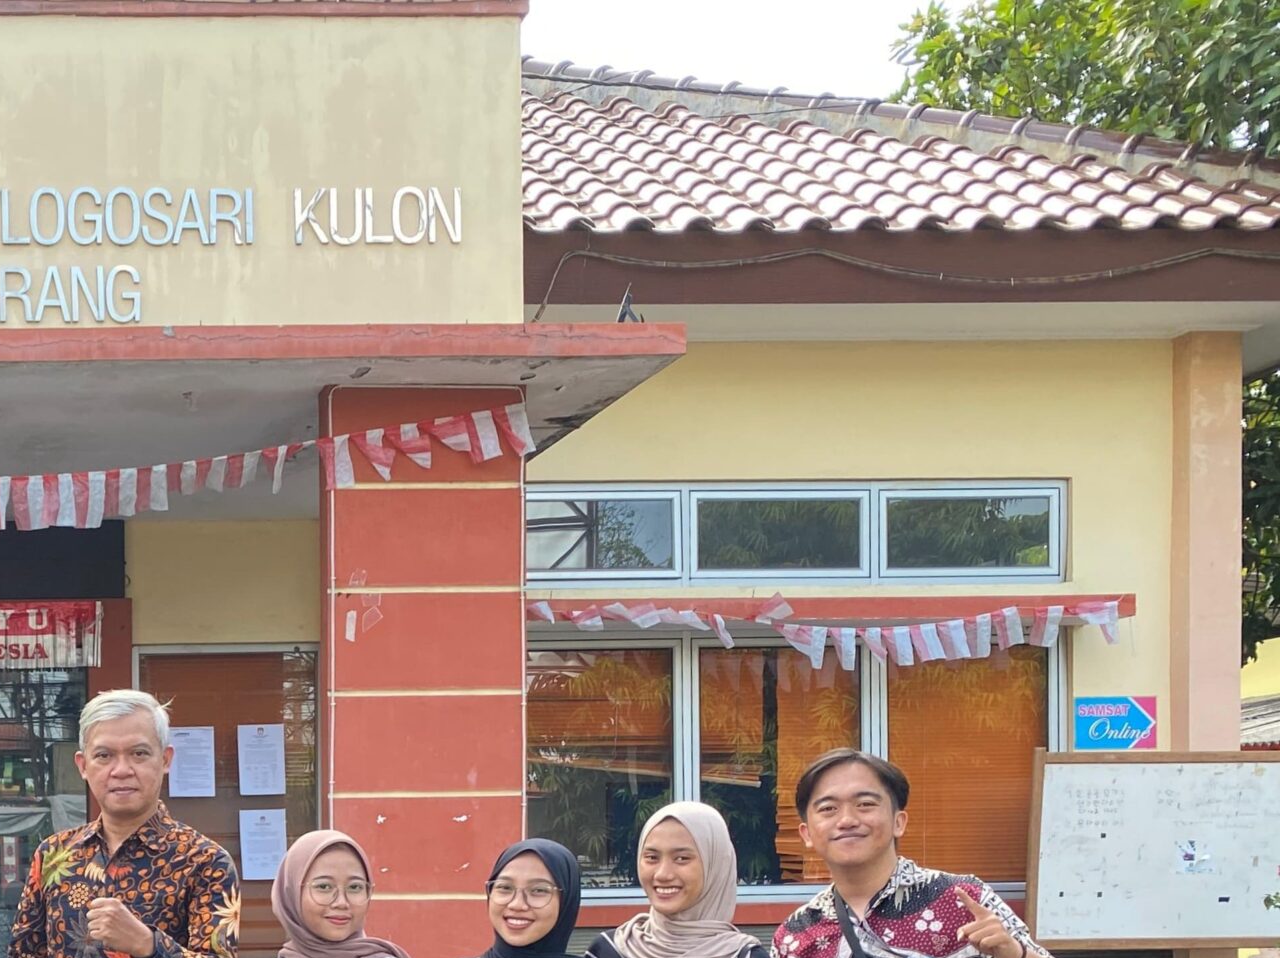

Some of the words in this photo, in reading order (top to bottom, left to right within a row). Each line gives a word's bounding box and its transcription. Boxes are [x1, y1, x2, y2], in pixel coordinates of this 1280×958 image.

[293, 185, 462, 246] KULON
[1078, 704, 1130, 717] SAMSAT
[1088, 717, 1151, 741] Online
